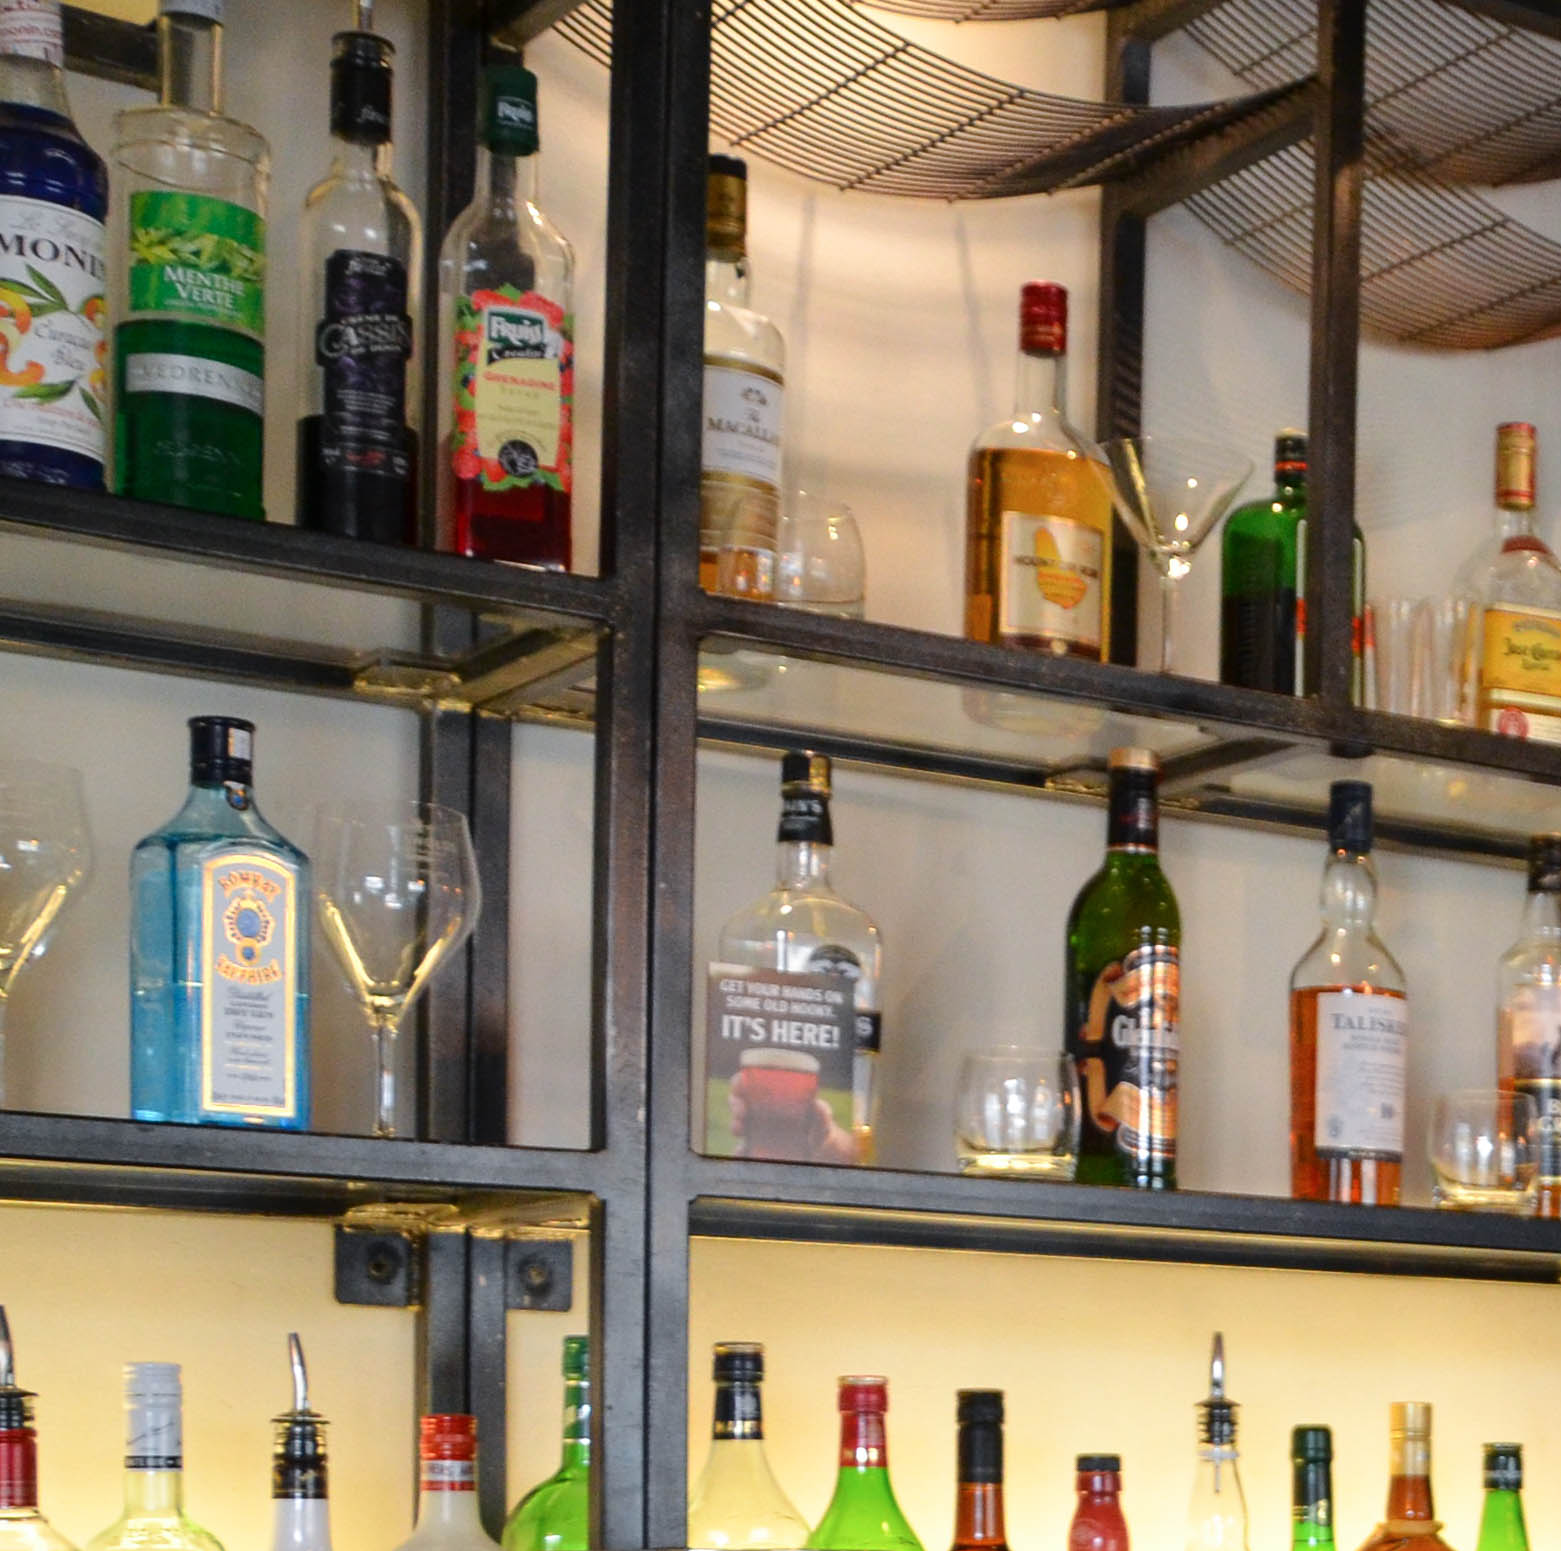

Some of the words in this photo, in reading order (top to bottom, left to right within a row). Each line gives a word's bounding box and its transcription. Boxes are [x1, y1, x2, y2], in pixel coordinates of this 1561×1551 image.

[164, 264, 246, 297] MENTHE
[176, 283, 235, 308] VERTE
[719, 979, 745, 993] GET
[747, 981, 780, 997] YOUR
[726, 995, 761, 1010] SOME
[763, 998, 789, 1013] OLD
[721, 1013, 768, 1042] IT'S
[770, 1018, 841, 1048] HERE!
